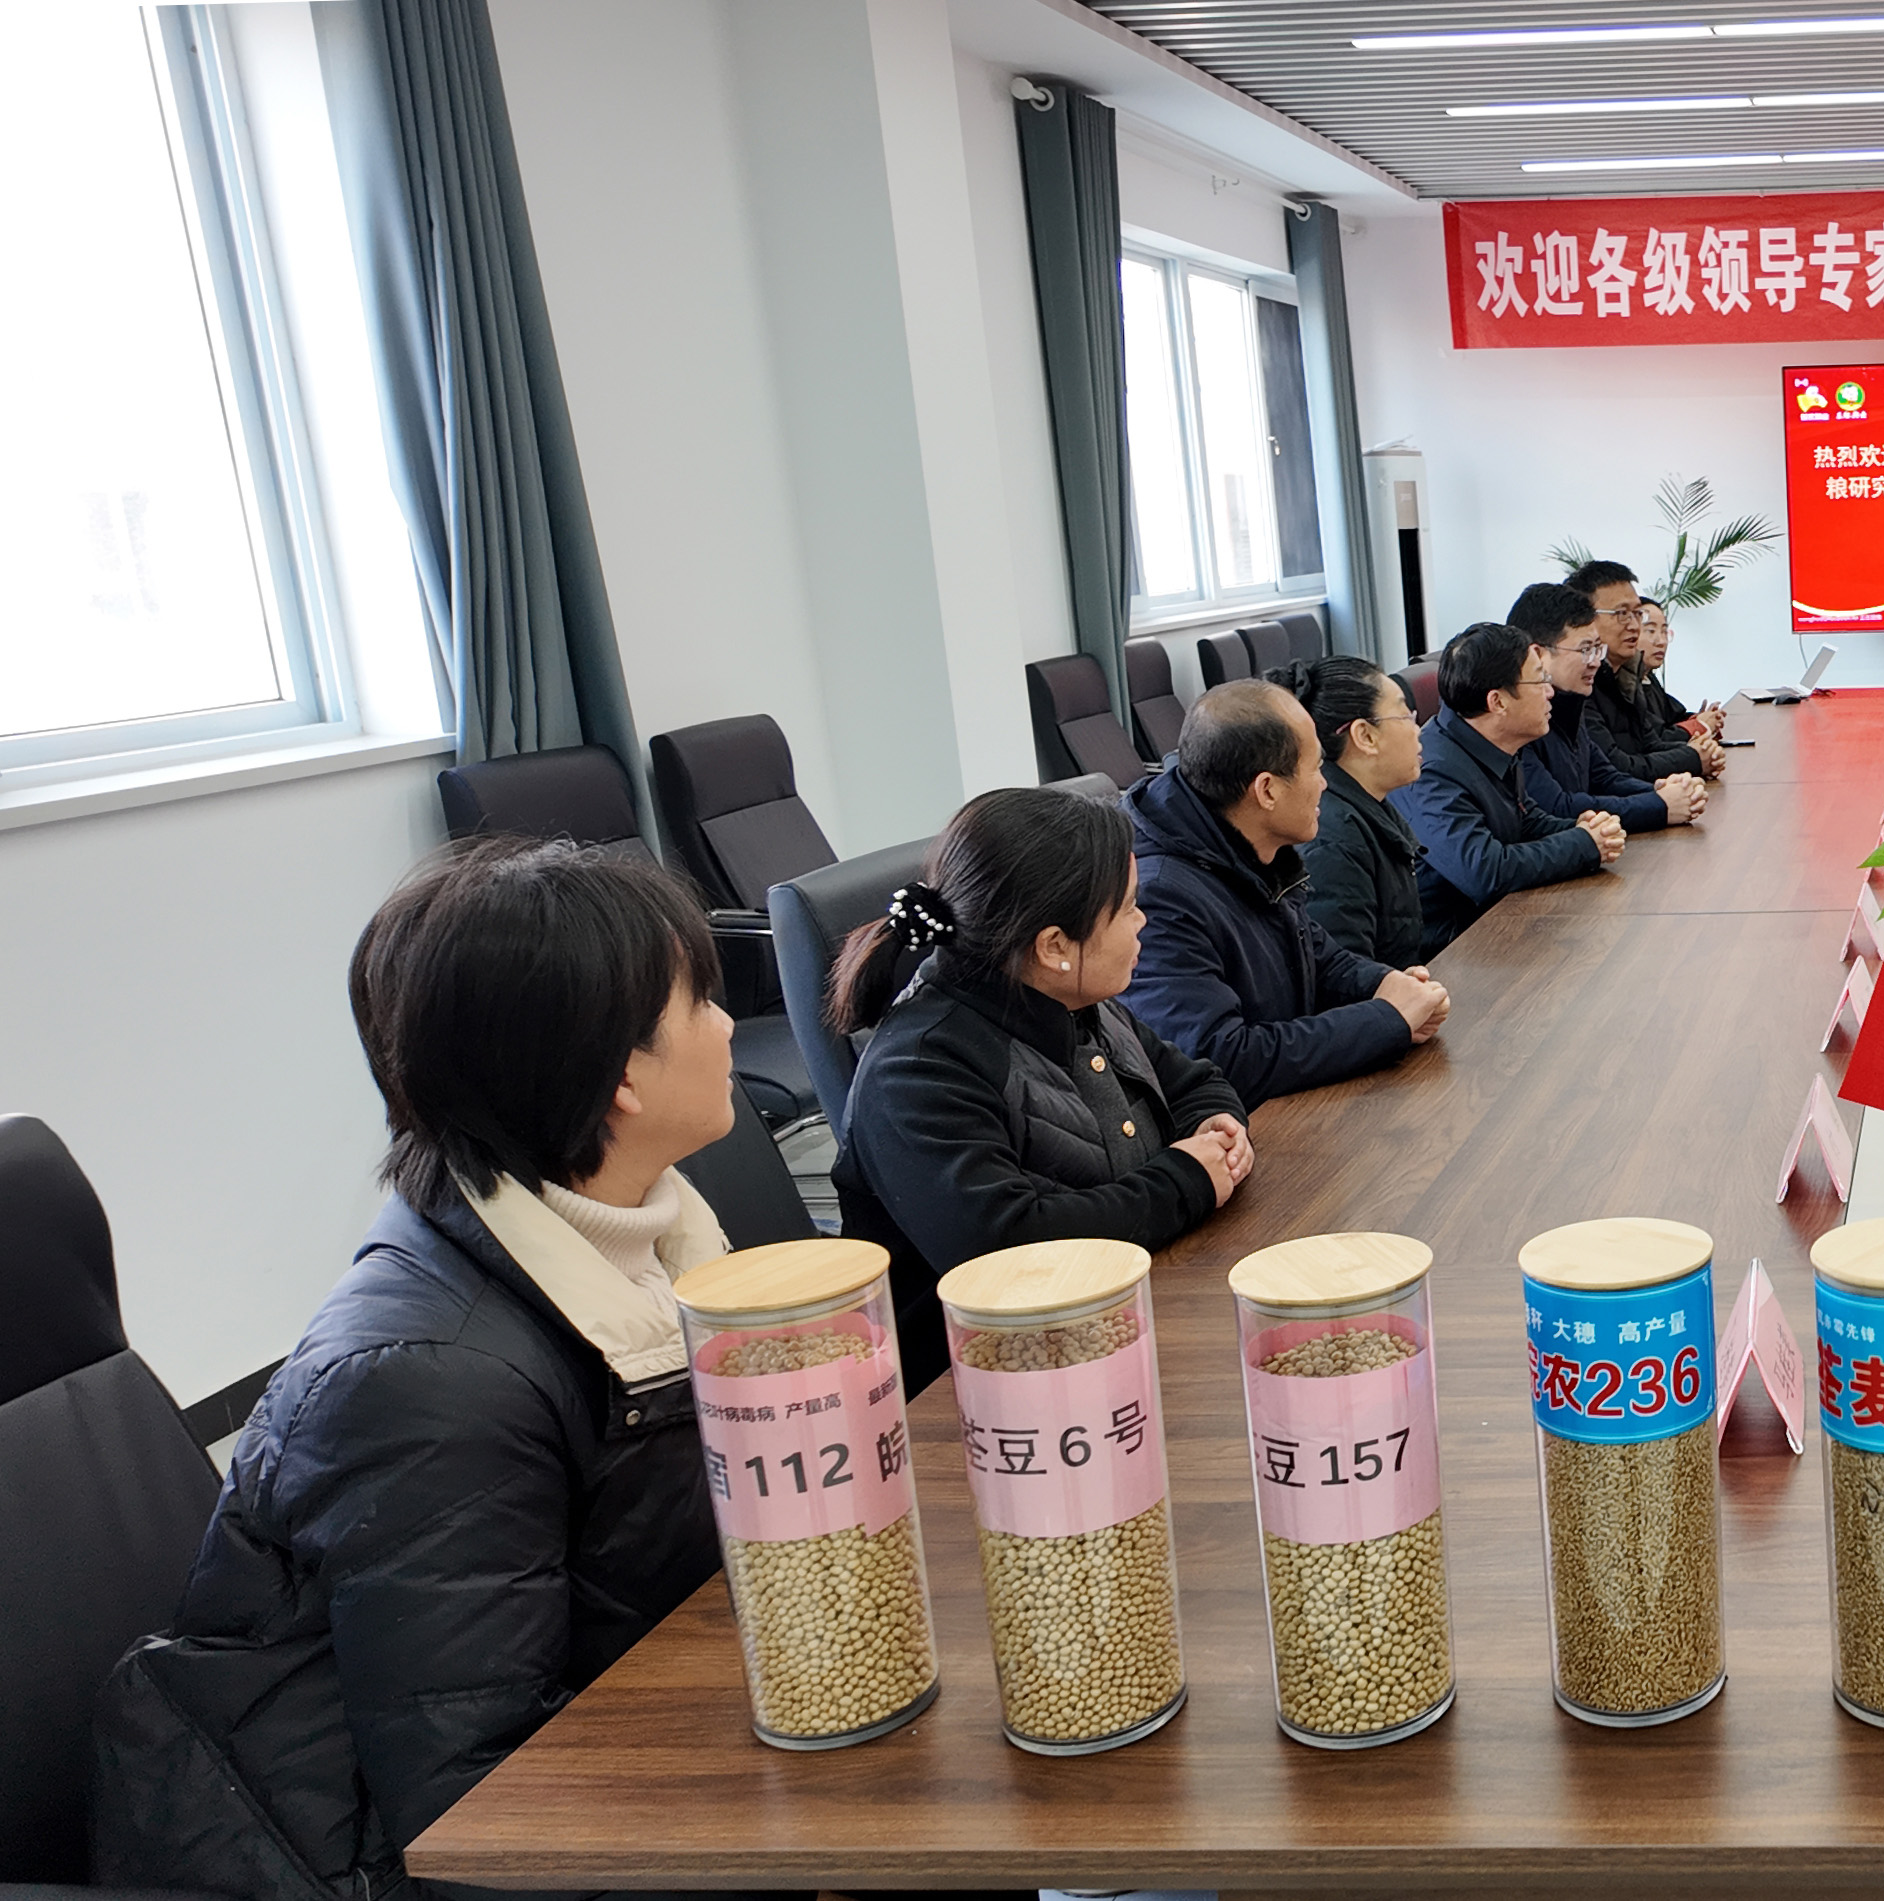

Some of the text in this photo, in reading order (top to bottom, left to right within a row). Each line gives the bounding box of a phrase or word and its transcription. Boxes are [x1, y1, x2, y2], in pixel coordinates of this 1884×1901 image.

[1552, 1318, 1596, 1344] 大穗
[1618, 1309, 1687, 1344] 高产量
[785, 1391, 842, 1419] 产量高
